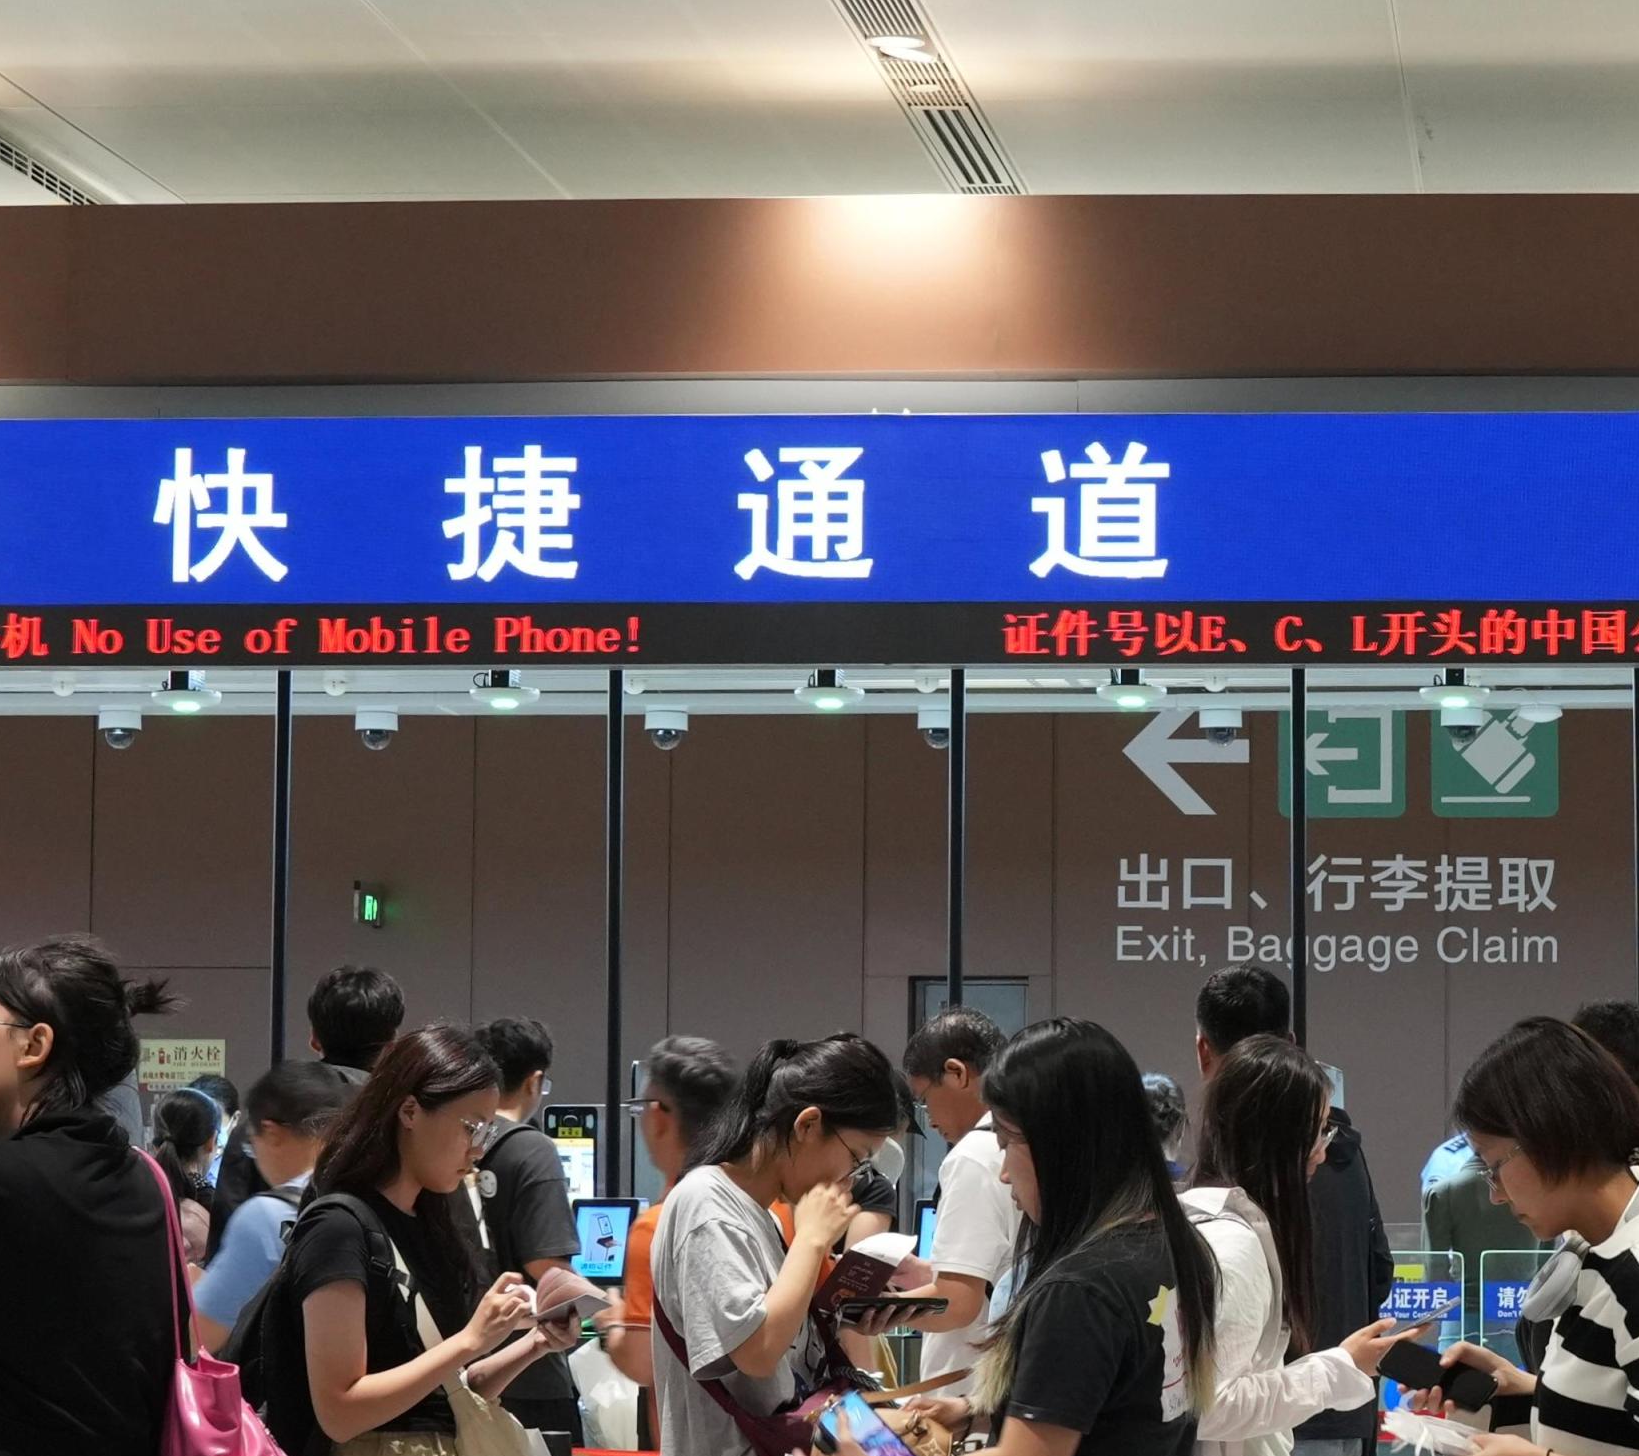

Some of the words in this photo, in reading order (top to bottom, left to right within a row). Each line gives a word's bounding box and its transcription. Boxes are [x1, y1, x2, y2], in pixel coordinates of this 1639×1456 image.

[152, 442, 1171, 583] 快捷通道
[72, 618, 124, 654] No
[146, 618, 221, 654] Use
[244, 617, 298, 654] of
[318, 616, 471, 654] Mobile
[494, 615, 641, 653] Phone!
[1117, 852, 1558, 912] 出口、行李提取
[1115, 924, 1208, 967] Exit,
[1436, 924, 1560, 964] Claim
[174, 1046, 221, 1061] 消火栓
[1497, 1287, 1530, 1309] 请勿
